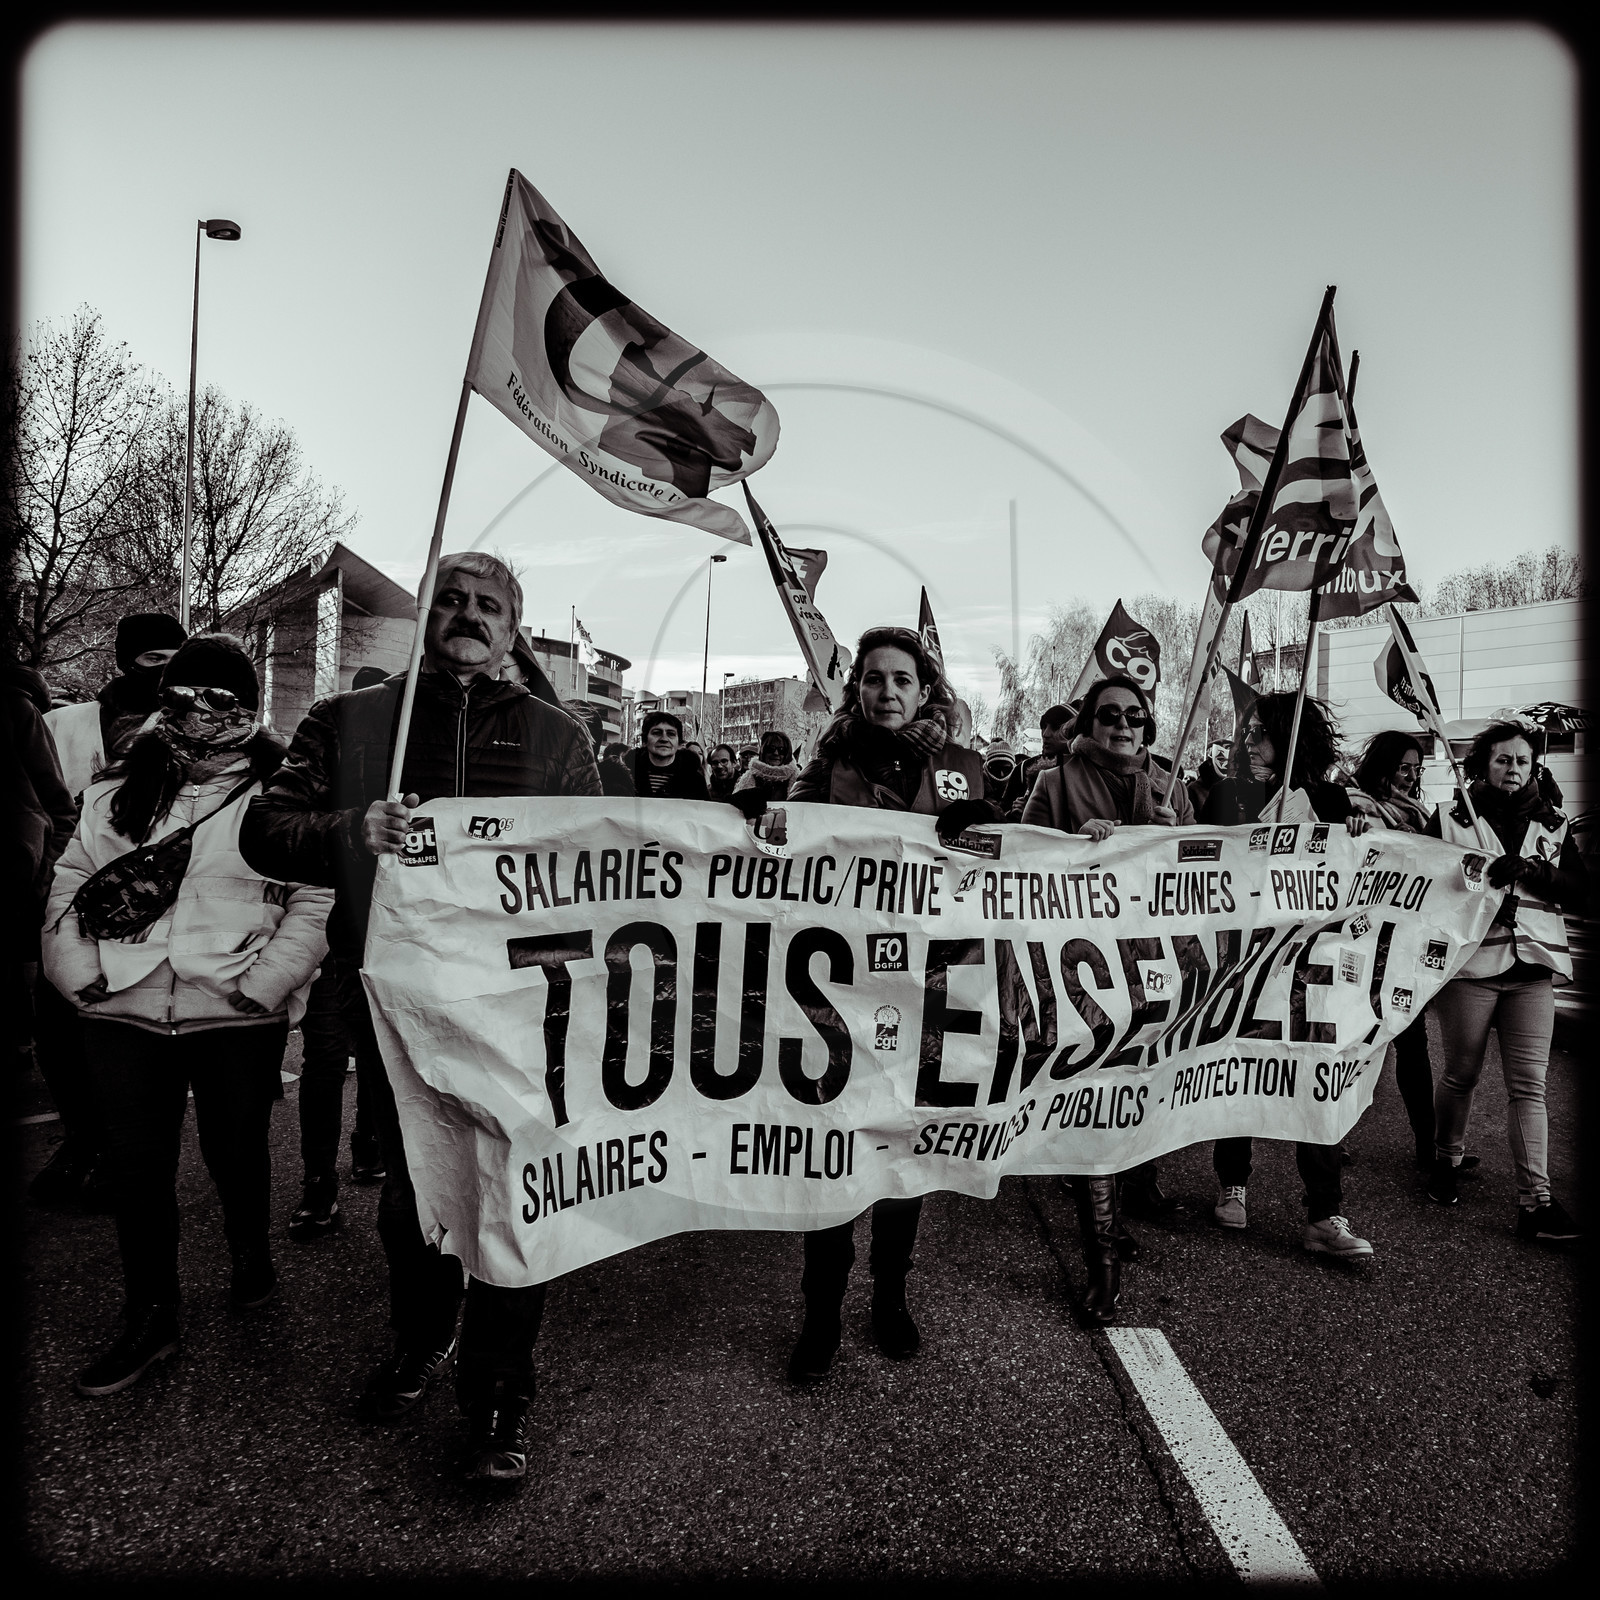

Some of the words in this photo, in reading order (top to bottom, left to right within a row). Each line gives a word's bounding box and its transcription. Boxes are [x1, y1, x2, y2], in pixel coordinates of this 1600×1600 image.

[506, 371, 569, 454] Fédération
[1255, 523, 1352, 569] Terri
[935, 769, 968, 791] FO
[405, 828, 436, 854] gt
[1251, 831, 1270, 845] cgt
[1275, 828, 1295, 848] FO
[1309, 838, 1328, 852] cgt
[495, 841, 683, 915] SALARIÉS
[706, 854, 948, 916] PUBLIC/PRIVÉ
[982, 864, 1120, 920] RETRAITÉS
[1148, 870, 1236, 917] JEUNES
[1271, 861, 1339, 911] PRIVÉS
[1345, 870, 1433, 912] D'EMPLOI
[875, 938, 902, 962] FO
[1425, 956, 1446, 968] cgt
[1393, 995, 1411, 1007] cgt
[506, 921, 854, 1128] TOUS
[914, 919, 1346, 1109] ENSEMBLE
[875, 1036, 897, 1049] cgt
[522, 1130, 668, 1225] SALAIRES
[729, 1123, 855, 1180] EMPLOI
[1041, 1085, 1149, 1130] PUBLICS
[1171, 1057, 1298, 1111] PROTECTION
